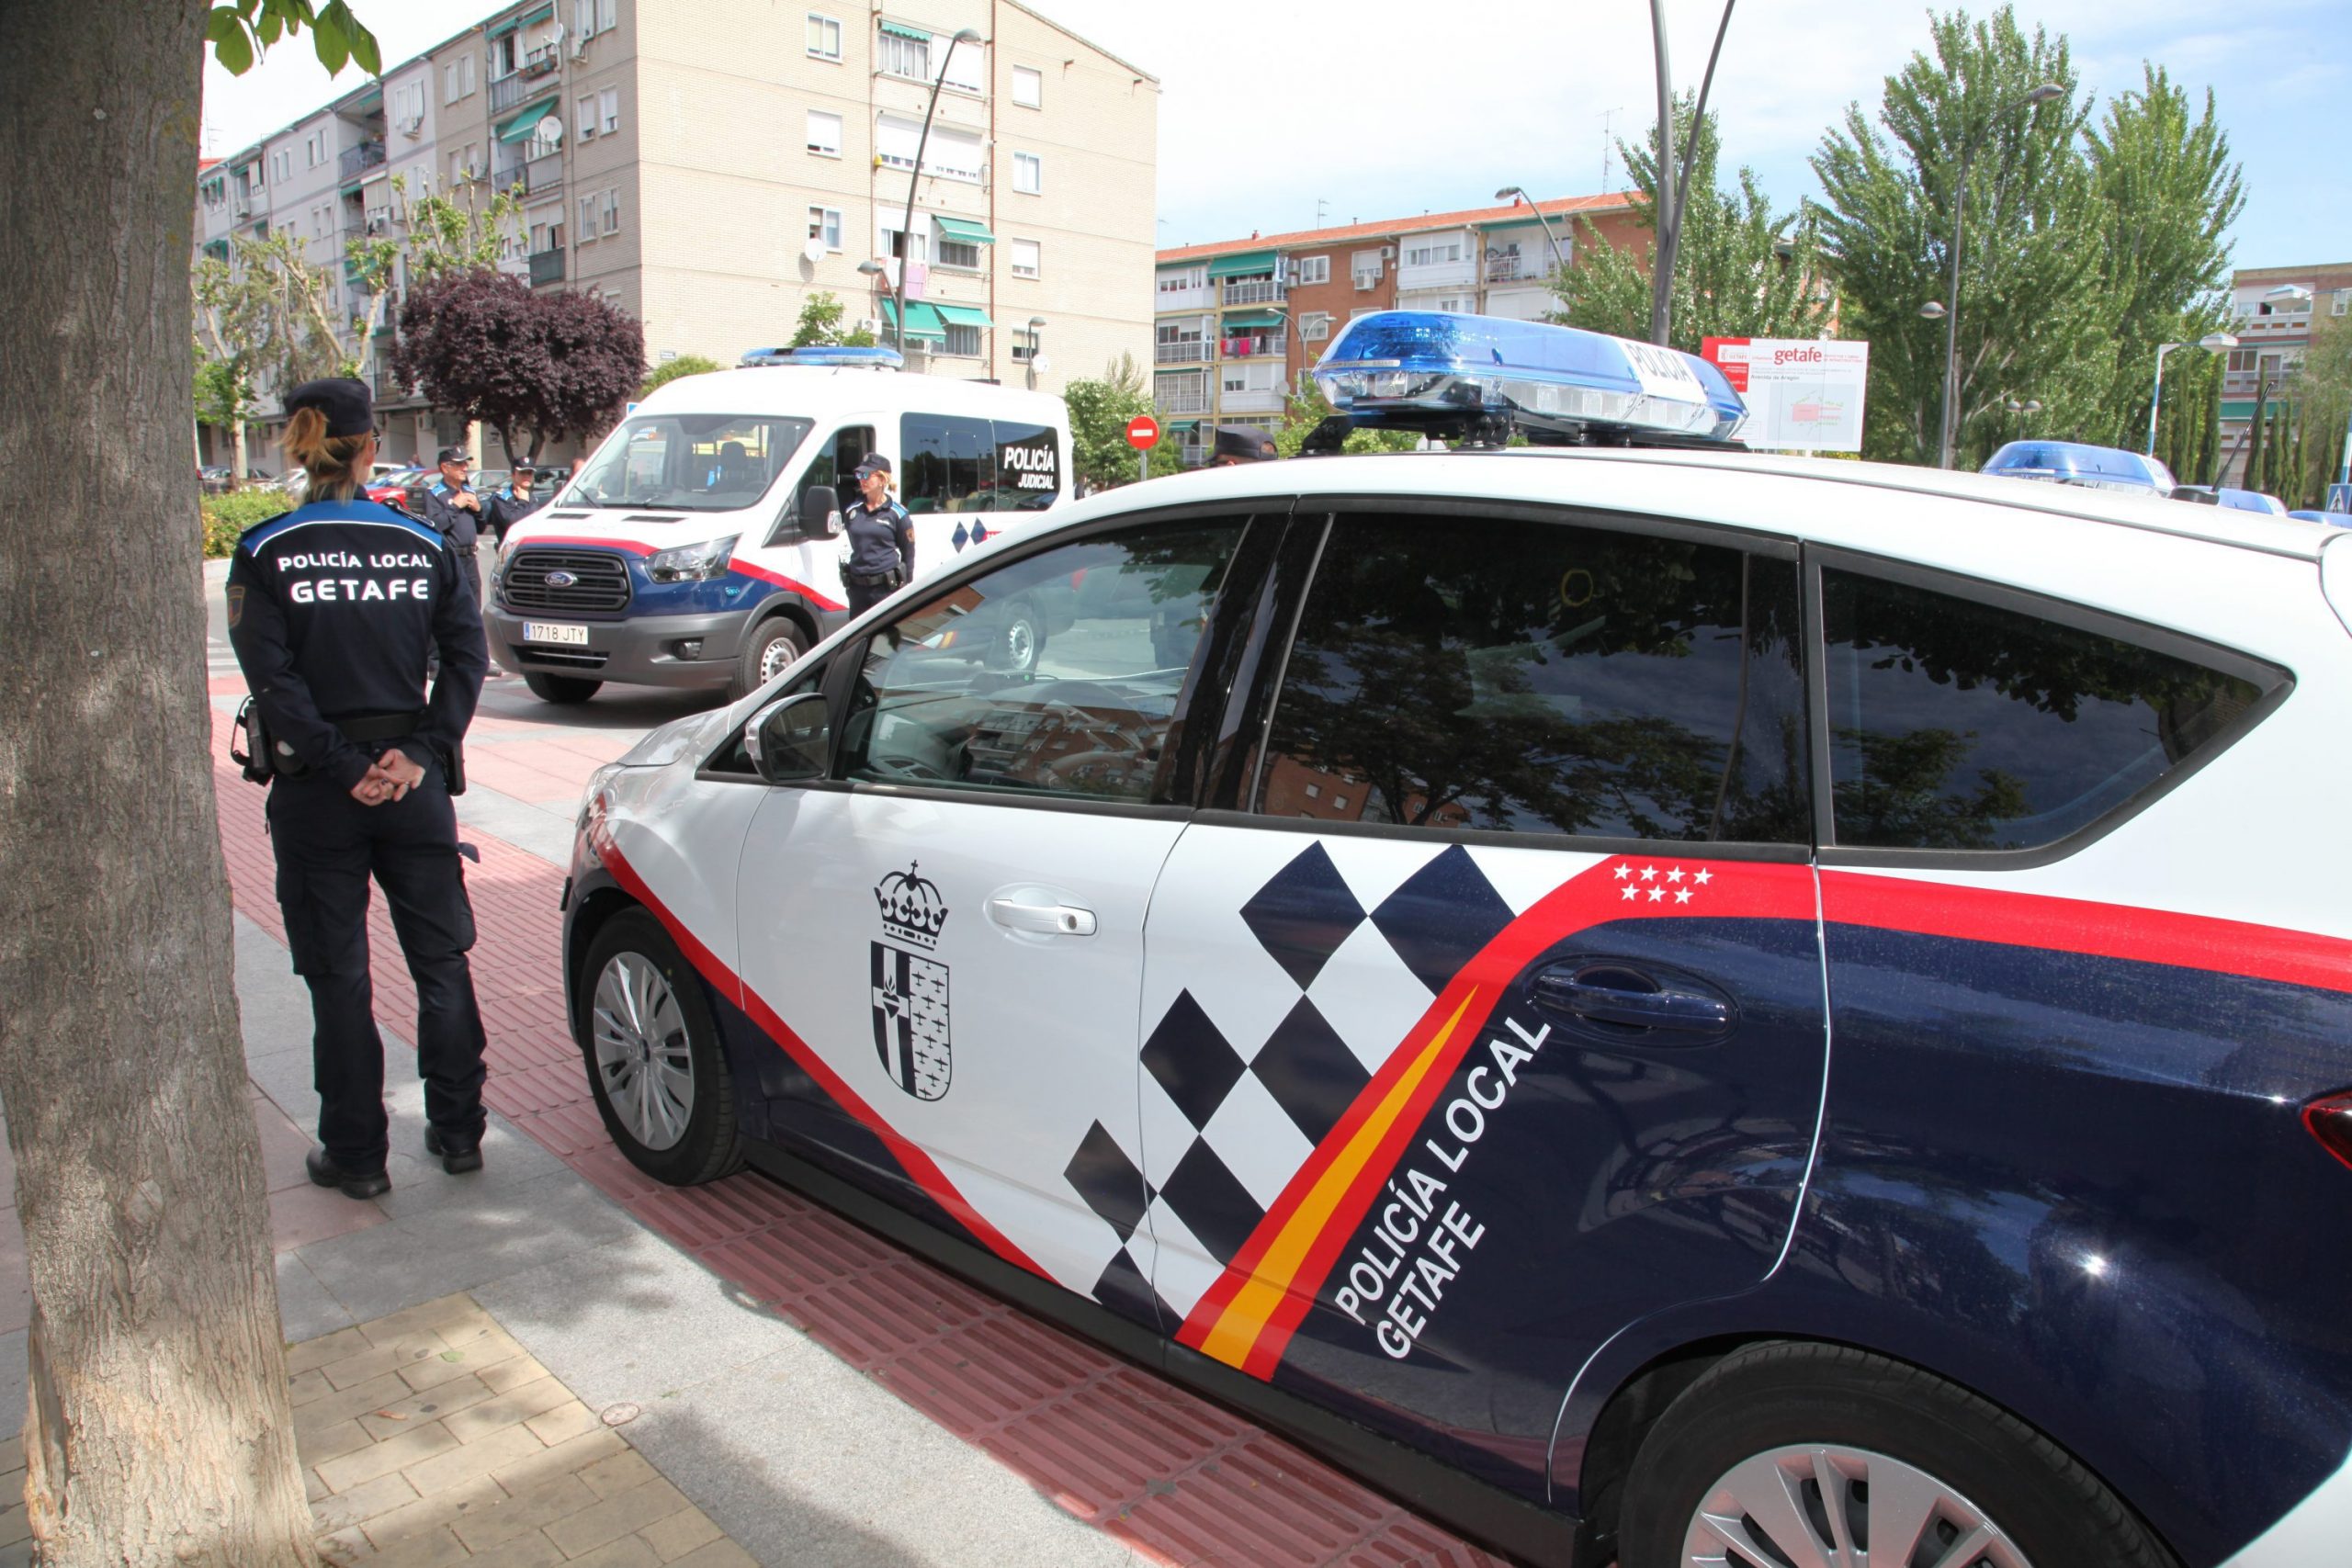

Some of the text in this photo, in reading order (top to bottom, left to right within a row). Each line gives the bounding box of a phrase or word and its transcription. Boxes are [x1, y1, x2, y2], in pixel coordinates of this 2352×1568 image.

[1774, 346, 1823, 366] getafe
[1003, 444, 1055, 472] POLICÍA
[1017, 473, 1055, 490] JUDICIAL
[277, 551, 433, 571] POLICÍA LOCAL
[290, 578, 429, 604] GETAFE
[532, 626, 585, 642] 1718 JTY
[1334, 1016, 1552, 1325] POLICÍA LOCAL
[1376, 1200, 1486, 1359] GETAFE
